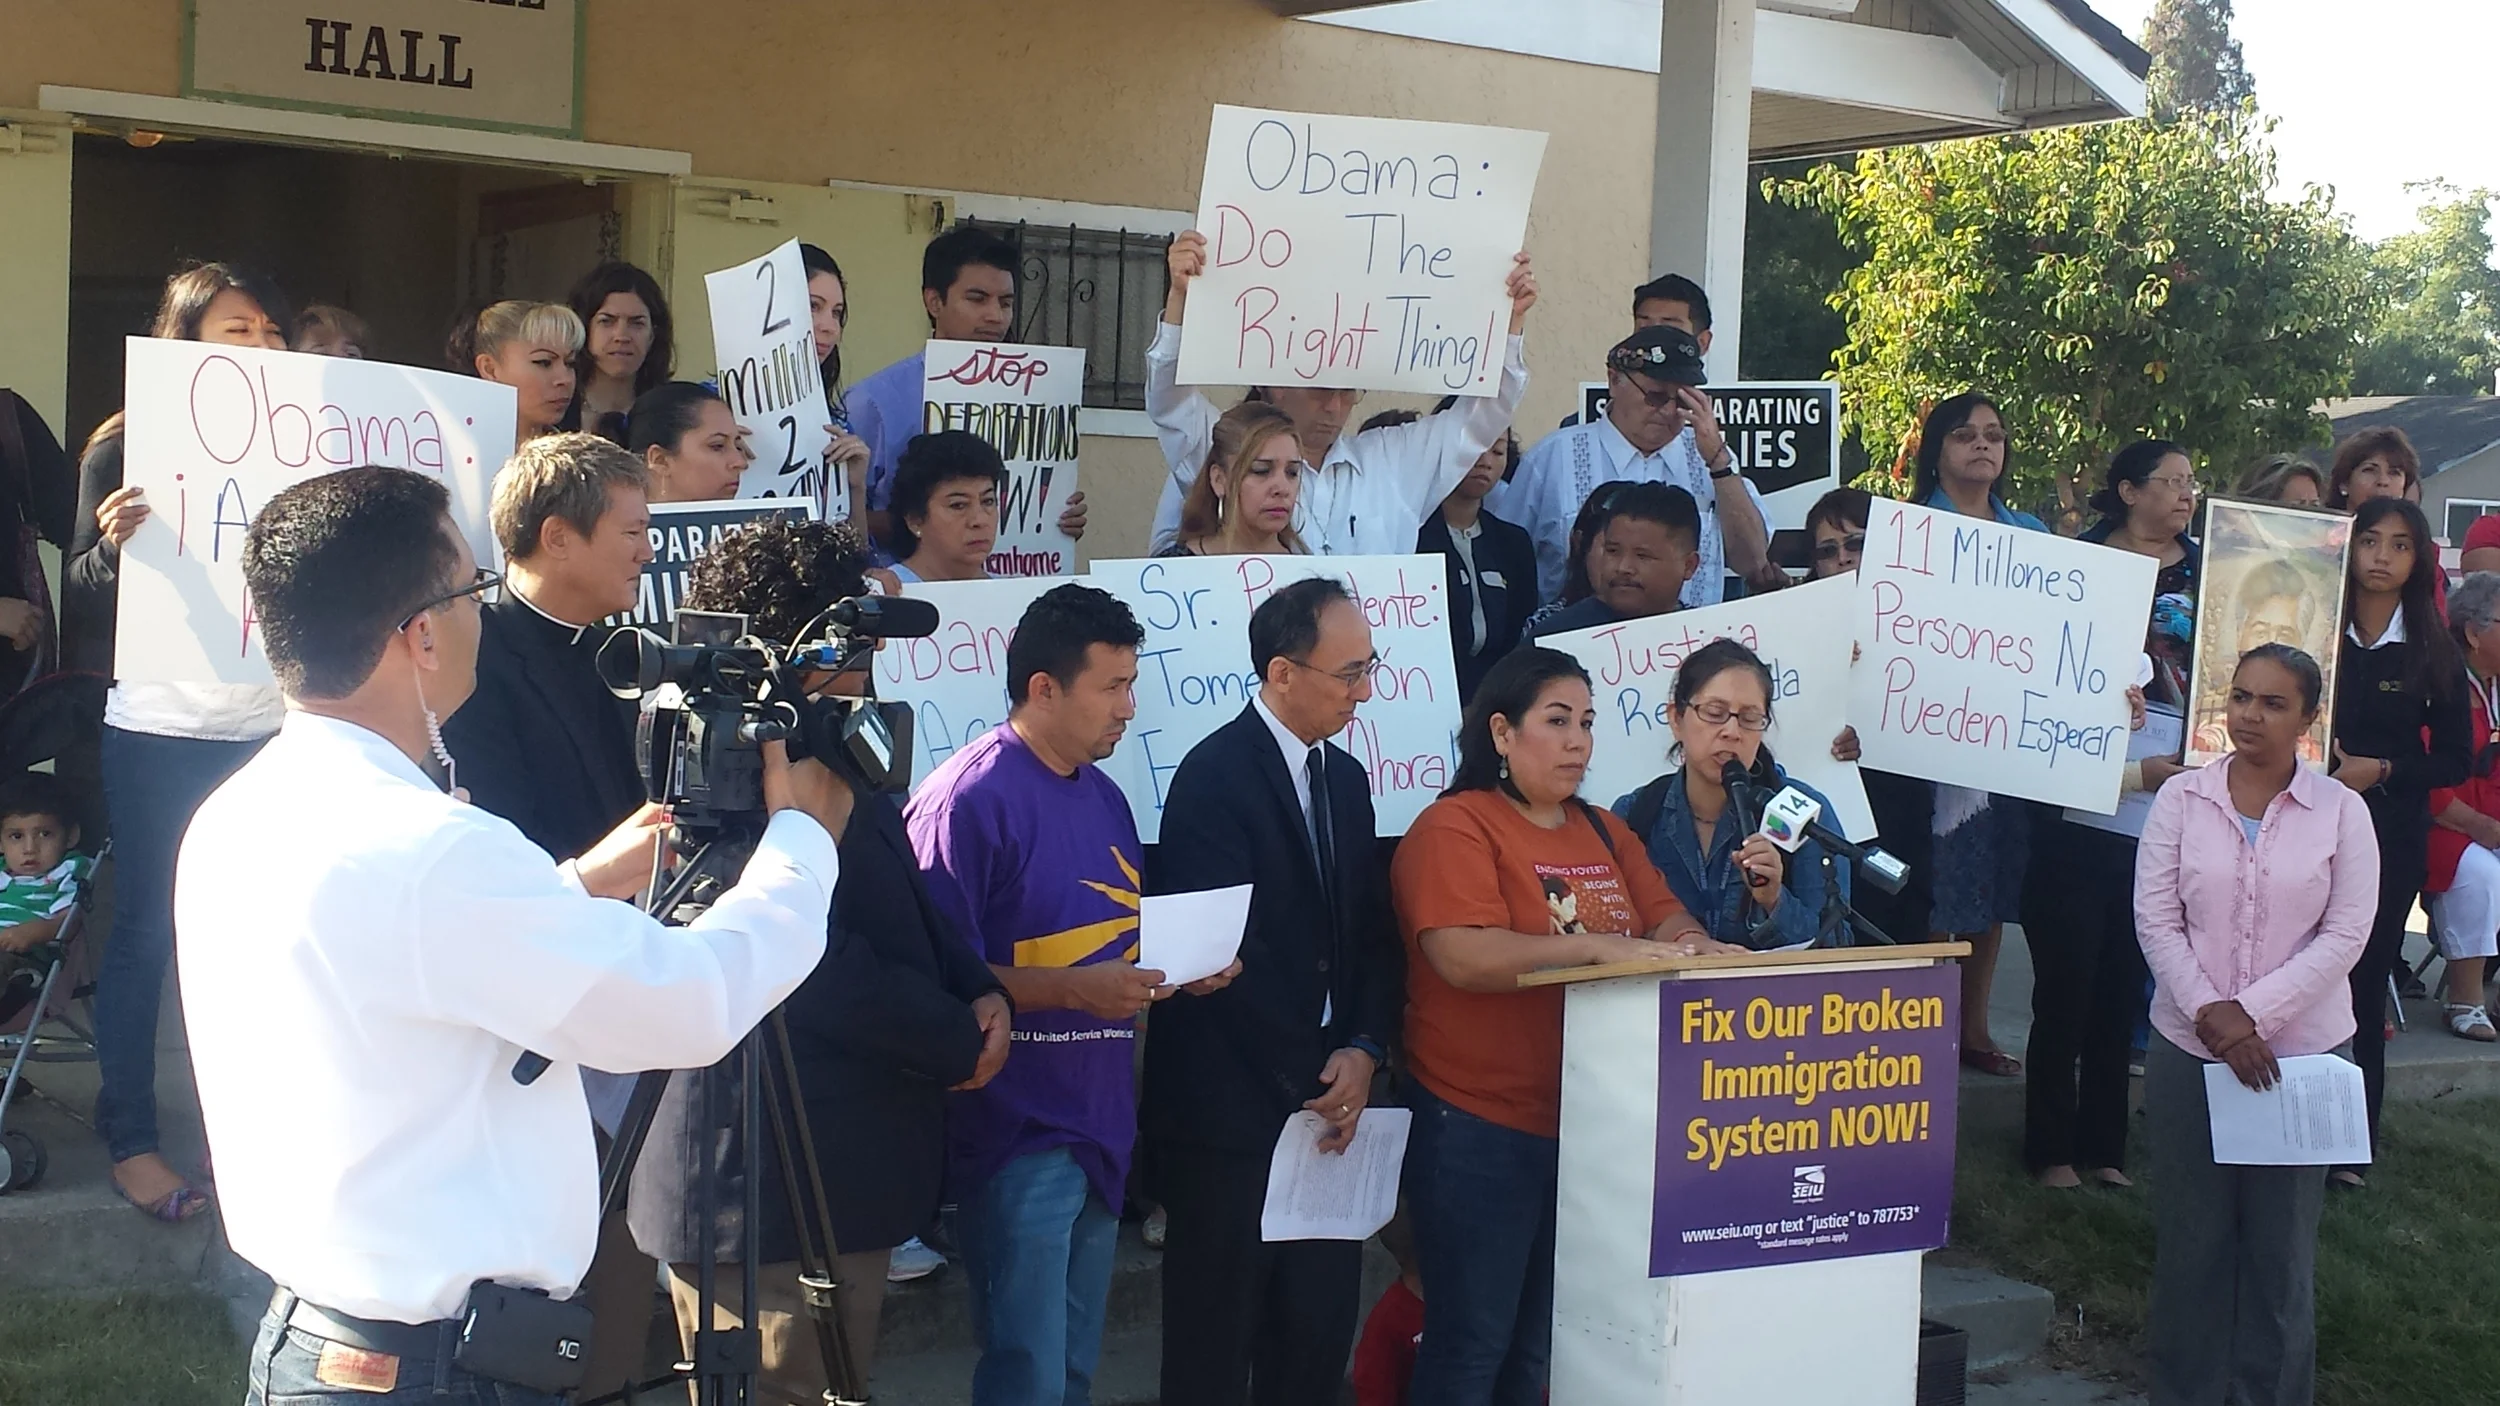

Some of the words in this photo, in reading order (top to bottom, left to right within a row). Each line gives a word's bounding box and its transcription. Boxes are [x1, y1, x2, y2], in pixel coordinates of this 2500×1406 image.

[304, 18, 473, 89] HALL
[1246, 120, 1490, 199] Obama:
[1215, 205, 1292, 268] Do
[1345, 213, 1456, 278] The
[756, 260, 791, 336] 2
[1235, 286, 1379, 379] Right
[1386, 296, 1495, 389] Thing!
[190, 355, 474, 473] Obama:
[1711, 397, 1821, 424] ARATING
[778, 416, 807, 476] 2
[1885, 510, 1935, 576] 11
[1952, 526, 2085, 602] Millones
[1140, 563, 1218, 630] Sr.
[1873, 580, 2034, 674] Persones
[2056, 620, 2106, 694] No
[1137, 647, 1261, 706] Tome
[1881, 656, 2008, 750] Pueden
[2018, 690, 2125, 768] Esperar
[1779, 794, 1810, 816] 14
[1534, 864, 1571, 876] ENDING
[1571, 865, 1610, 876] POVERTY
[1583, 879, 1619, 889] BEGINS
[1610, 910, 1630, 919] YOU
[1011, 1031, 1031, 1041] EIU
[1033, 1030, 1069, 1042] United
[1071, 1030, 1102, 1041] Service
[1681, 998, 1736, 1044] Fix
[1745, 997, 1813, 1040] Our
[1822, 988, 1944, 1035] Broken
[1702, 1045, 1922, 1106] Immigration
[1686, 1115, 1820, 1171] System
[1829, 1101, 1930, 1148] NOW!
[1792, 1184, 1824, 1198] SEIU
[1682, 1222, 1763, 1244] www.seiu.org
[1766, 1223, 1779, 1234] or
[1781, 1216, 1804, 1233] text
[1857, 1211, 1870, 1225] to
[1831, 1231, 1849, 1244] apply
